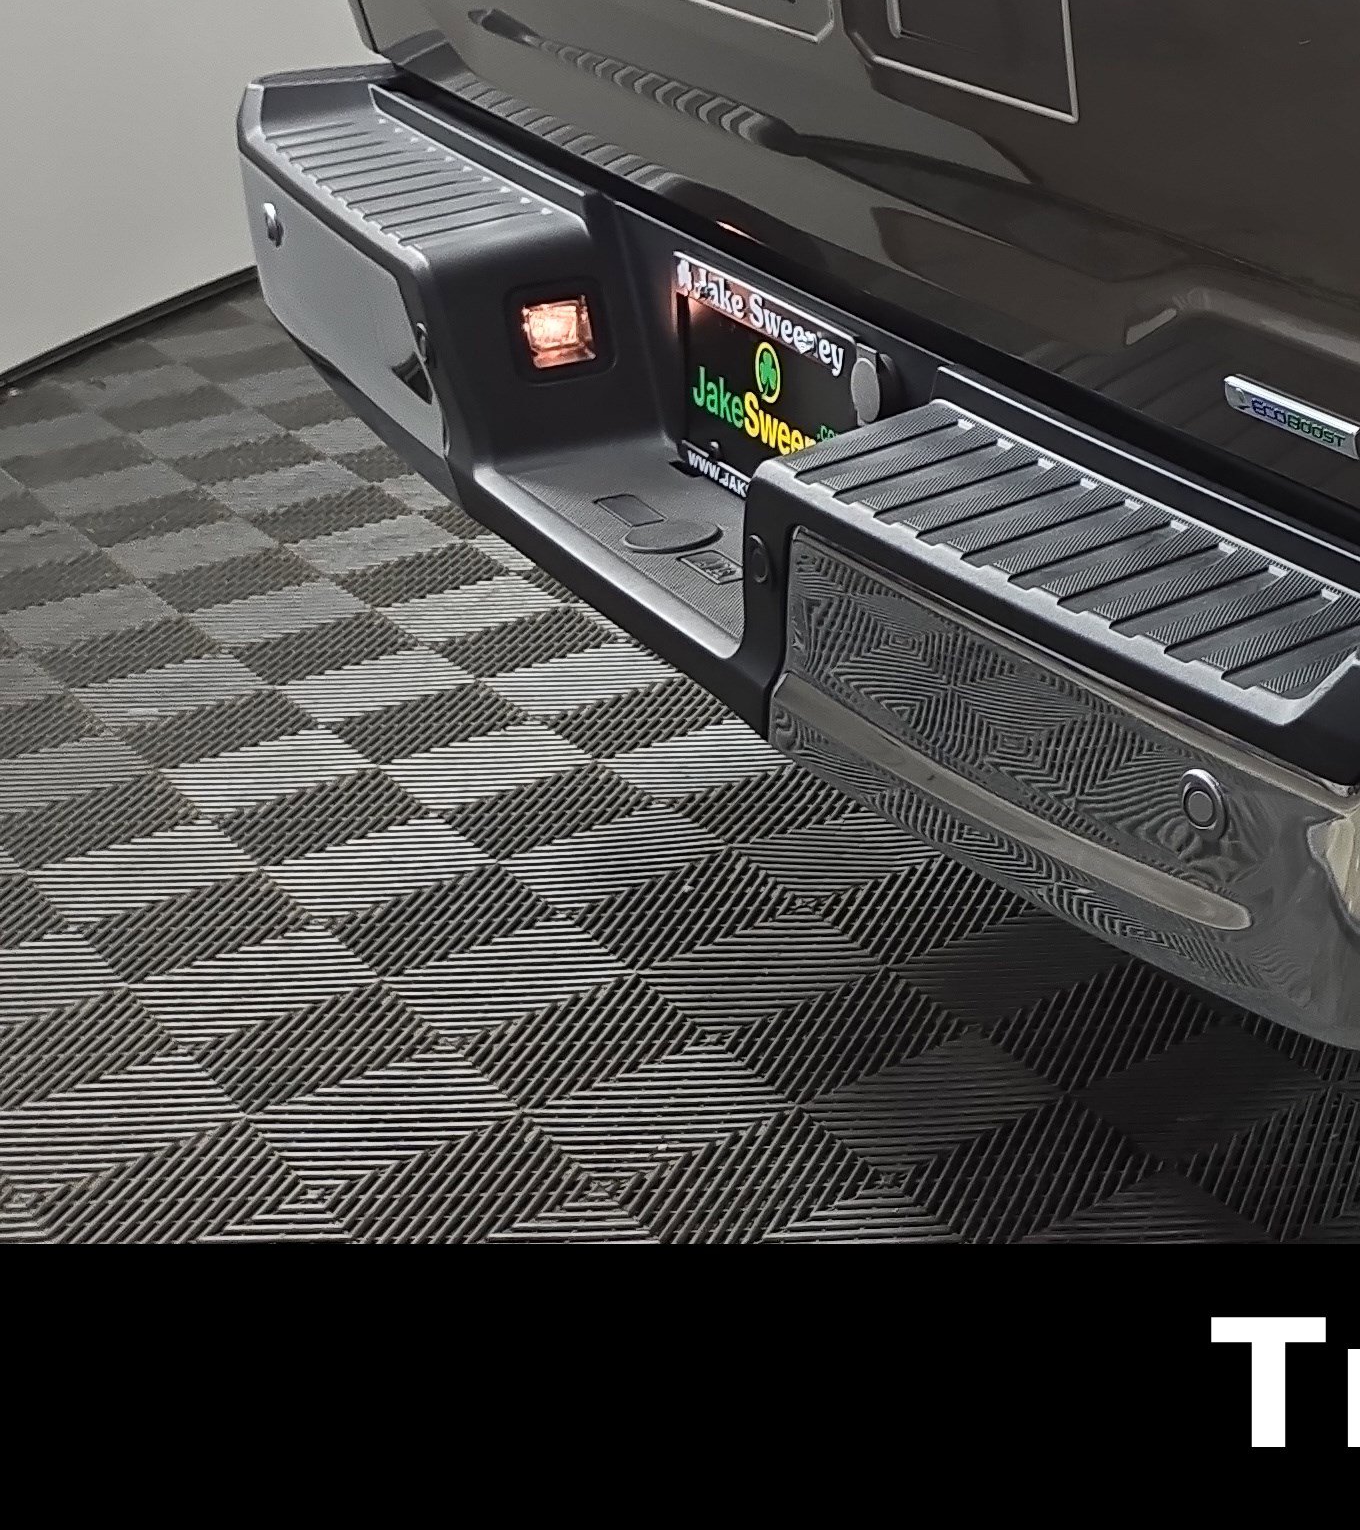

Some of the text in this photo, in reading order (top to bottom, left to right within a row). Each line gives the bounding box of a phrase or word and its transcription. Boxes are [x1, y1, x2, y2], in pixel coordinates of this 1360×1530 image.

[693, 268, 845, 377] Jake Sweeney
[1251, 397, 1347, 448] ECOBOOST
[687, 449, 751, 499] WWW.JAK
